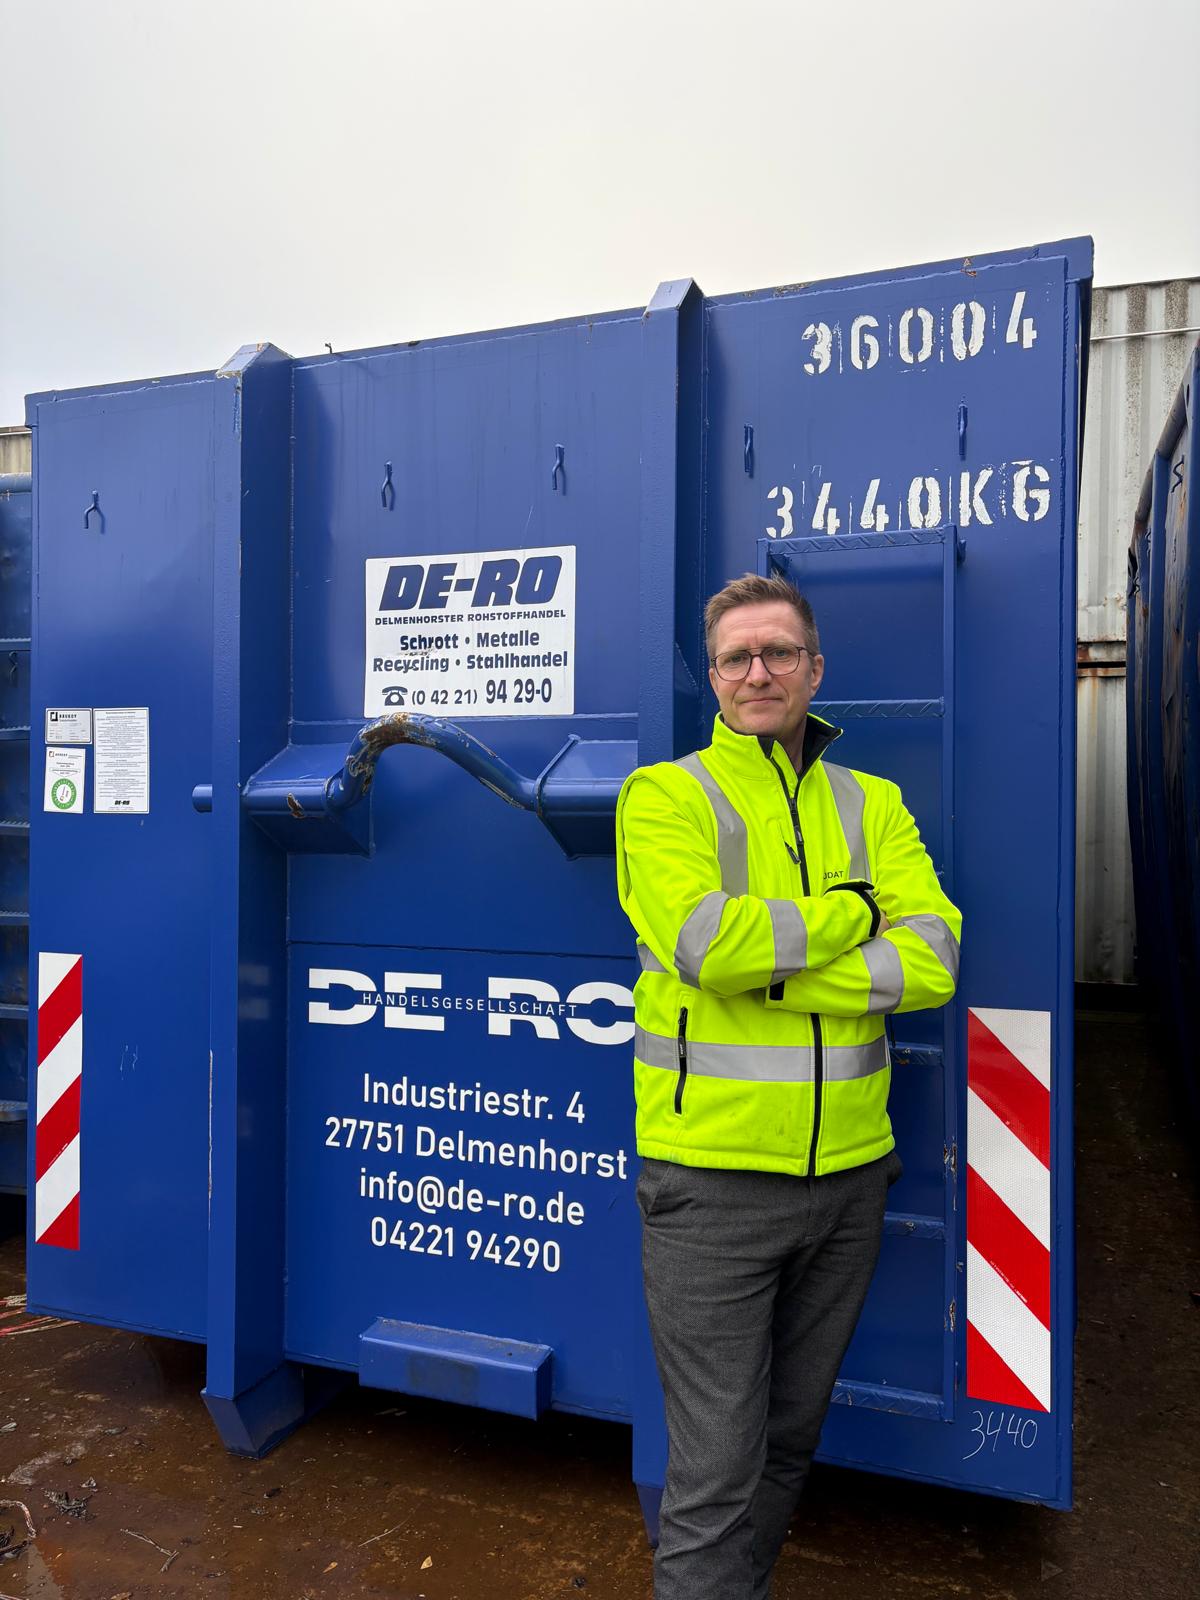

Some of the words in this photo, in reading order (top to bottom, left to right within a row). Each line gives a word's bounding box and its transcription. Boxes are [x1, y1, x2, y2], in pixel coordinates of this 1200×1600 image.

[801, 291, 1037, 375] 36004
[378, 555, 563, 612] DE-RO
[374, 614, 464, 626] DELMENHORSTER
[467, 609, 566, 622] ROHSTOFFHANDEL
[400, 633, 459, 651] Schrott
[476, 630, 540, 648] Metalle
[373, 655, 450, 674] Recycling
[466, 651, 568, 670] Stahlhandel
[411, 689, 425, 705] (0
[430, 689, 448, 705] 42
[454, 689, 478, 705] 21)
[485, 679, 508, 704] 94
[513, 678, 553, 704] 29-0
[362, 992, 577, 1018] HANDELSGESELLSCHAFT
[363, 1072, 553, 1121] Industriestr.
[566, 1091, 585, 1124] 4
[325, 1116, 404, 1154] 27751
[416, 1126, 627, 1180] Delmenhorst
[359, 1167, 585, 1226] info@de-ro.de
[371, 1216, 454, 1258] 04221
[466, 1229, 561, 1273] 94290
[962, 1411, 1038, 1461] 3440
